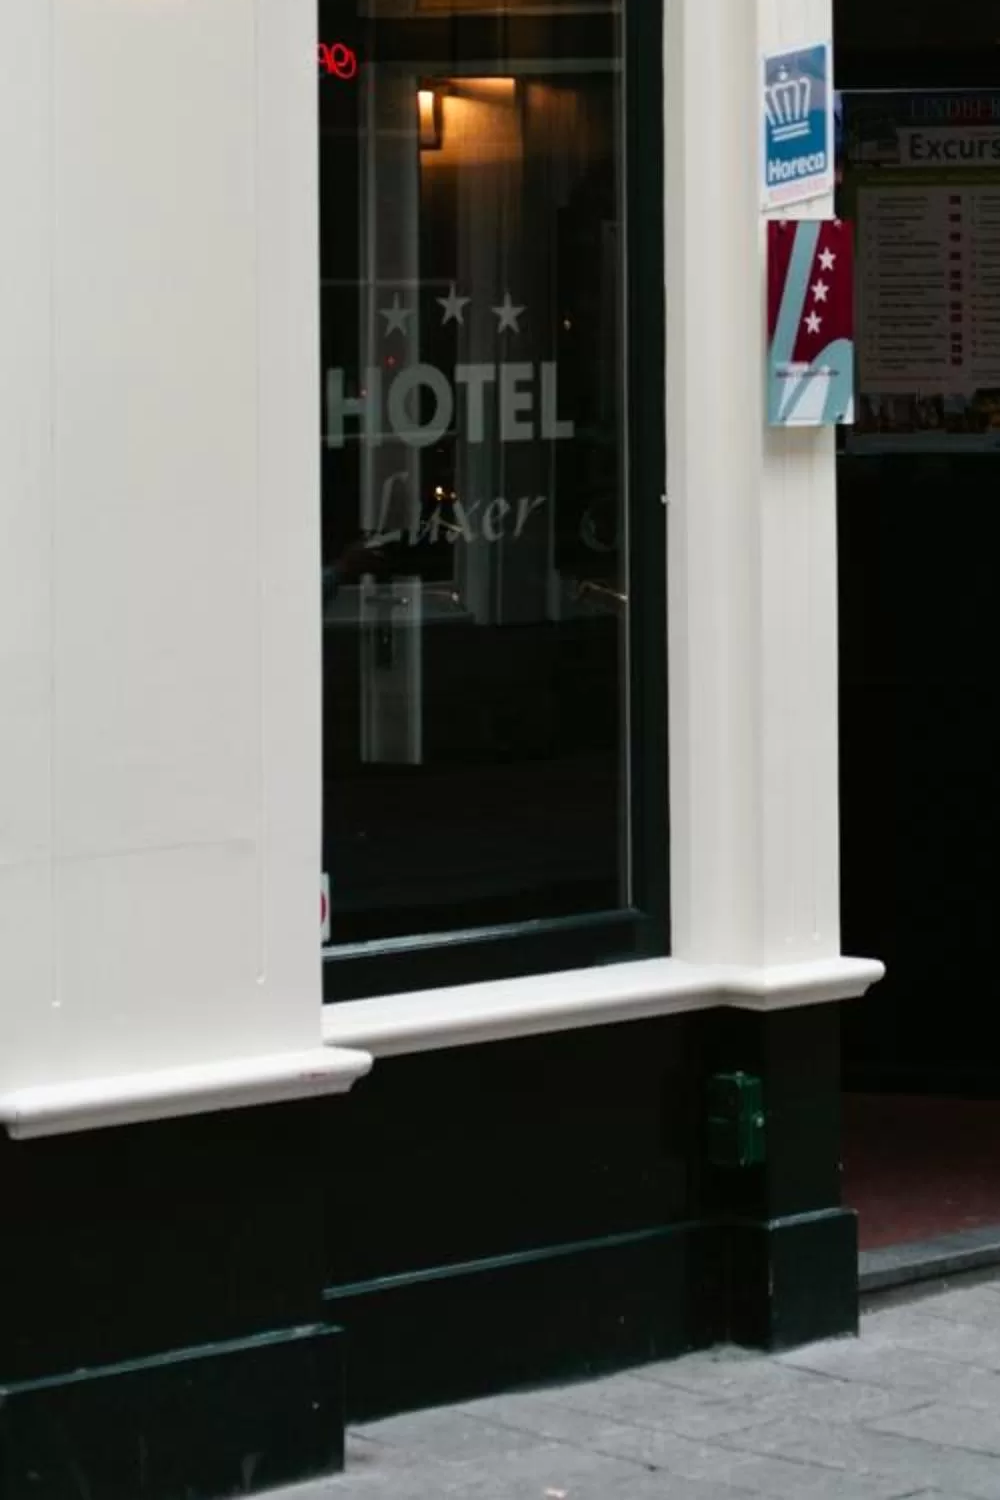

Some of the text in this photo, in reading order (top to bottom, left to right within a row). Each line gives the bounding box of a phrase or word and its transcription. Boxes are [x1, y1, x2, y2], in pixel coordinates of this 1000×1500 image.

[768, 151, 825, 182] Horeca
[327, 361, 574, 448] HOTEL
[364, 472, 546, 548] Luxer
